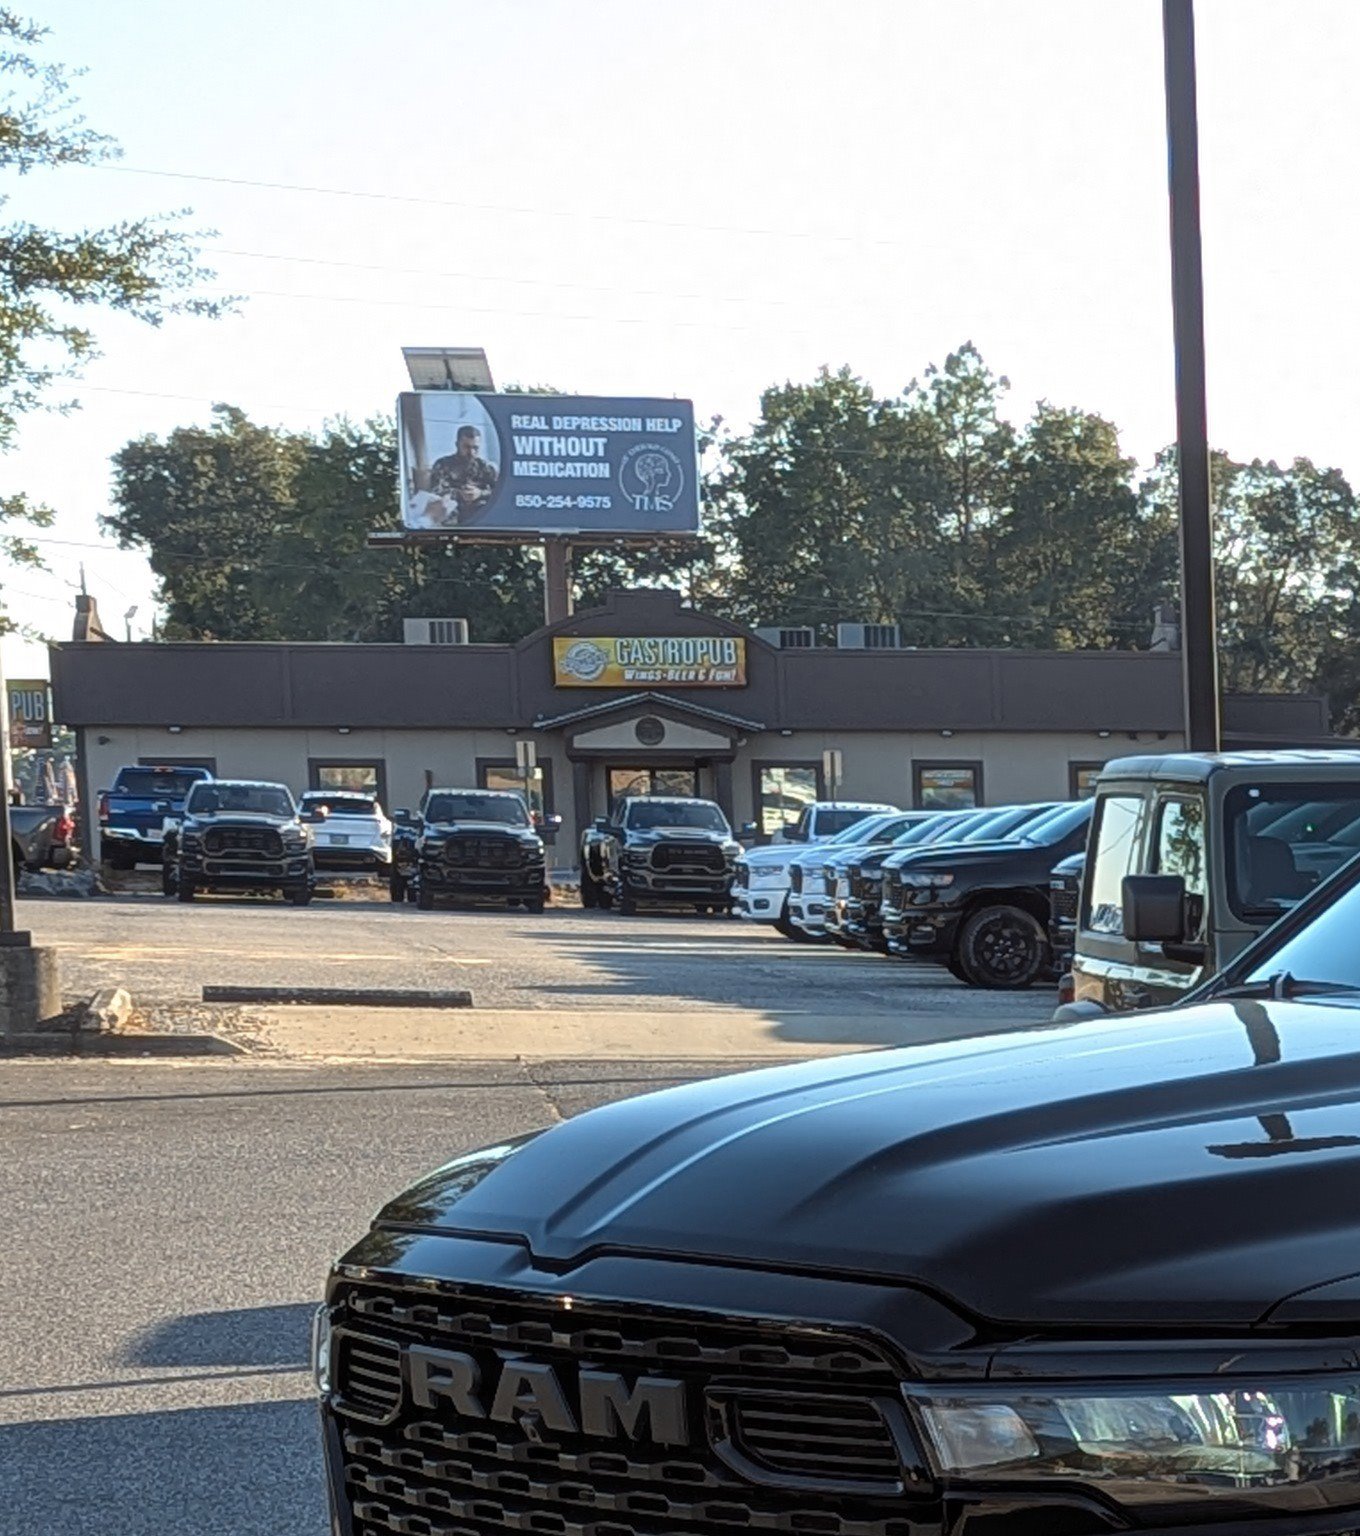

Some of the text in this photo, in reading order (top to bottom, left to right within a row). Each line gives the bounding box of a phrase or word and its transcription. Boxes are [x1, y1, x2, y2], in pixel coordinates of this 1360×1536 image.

[511, 415, 683, 433] REAL DEPRESSION HELP
[513, 435, 608, 457] WITHOUT
[513, 461, 610, 478] MEDICATION
[615, 638, 737, 666] GASTROPUB
[407, 1343, 690, 1446] RAM
